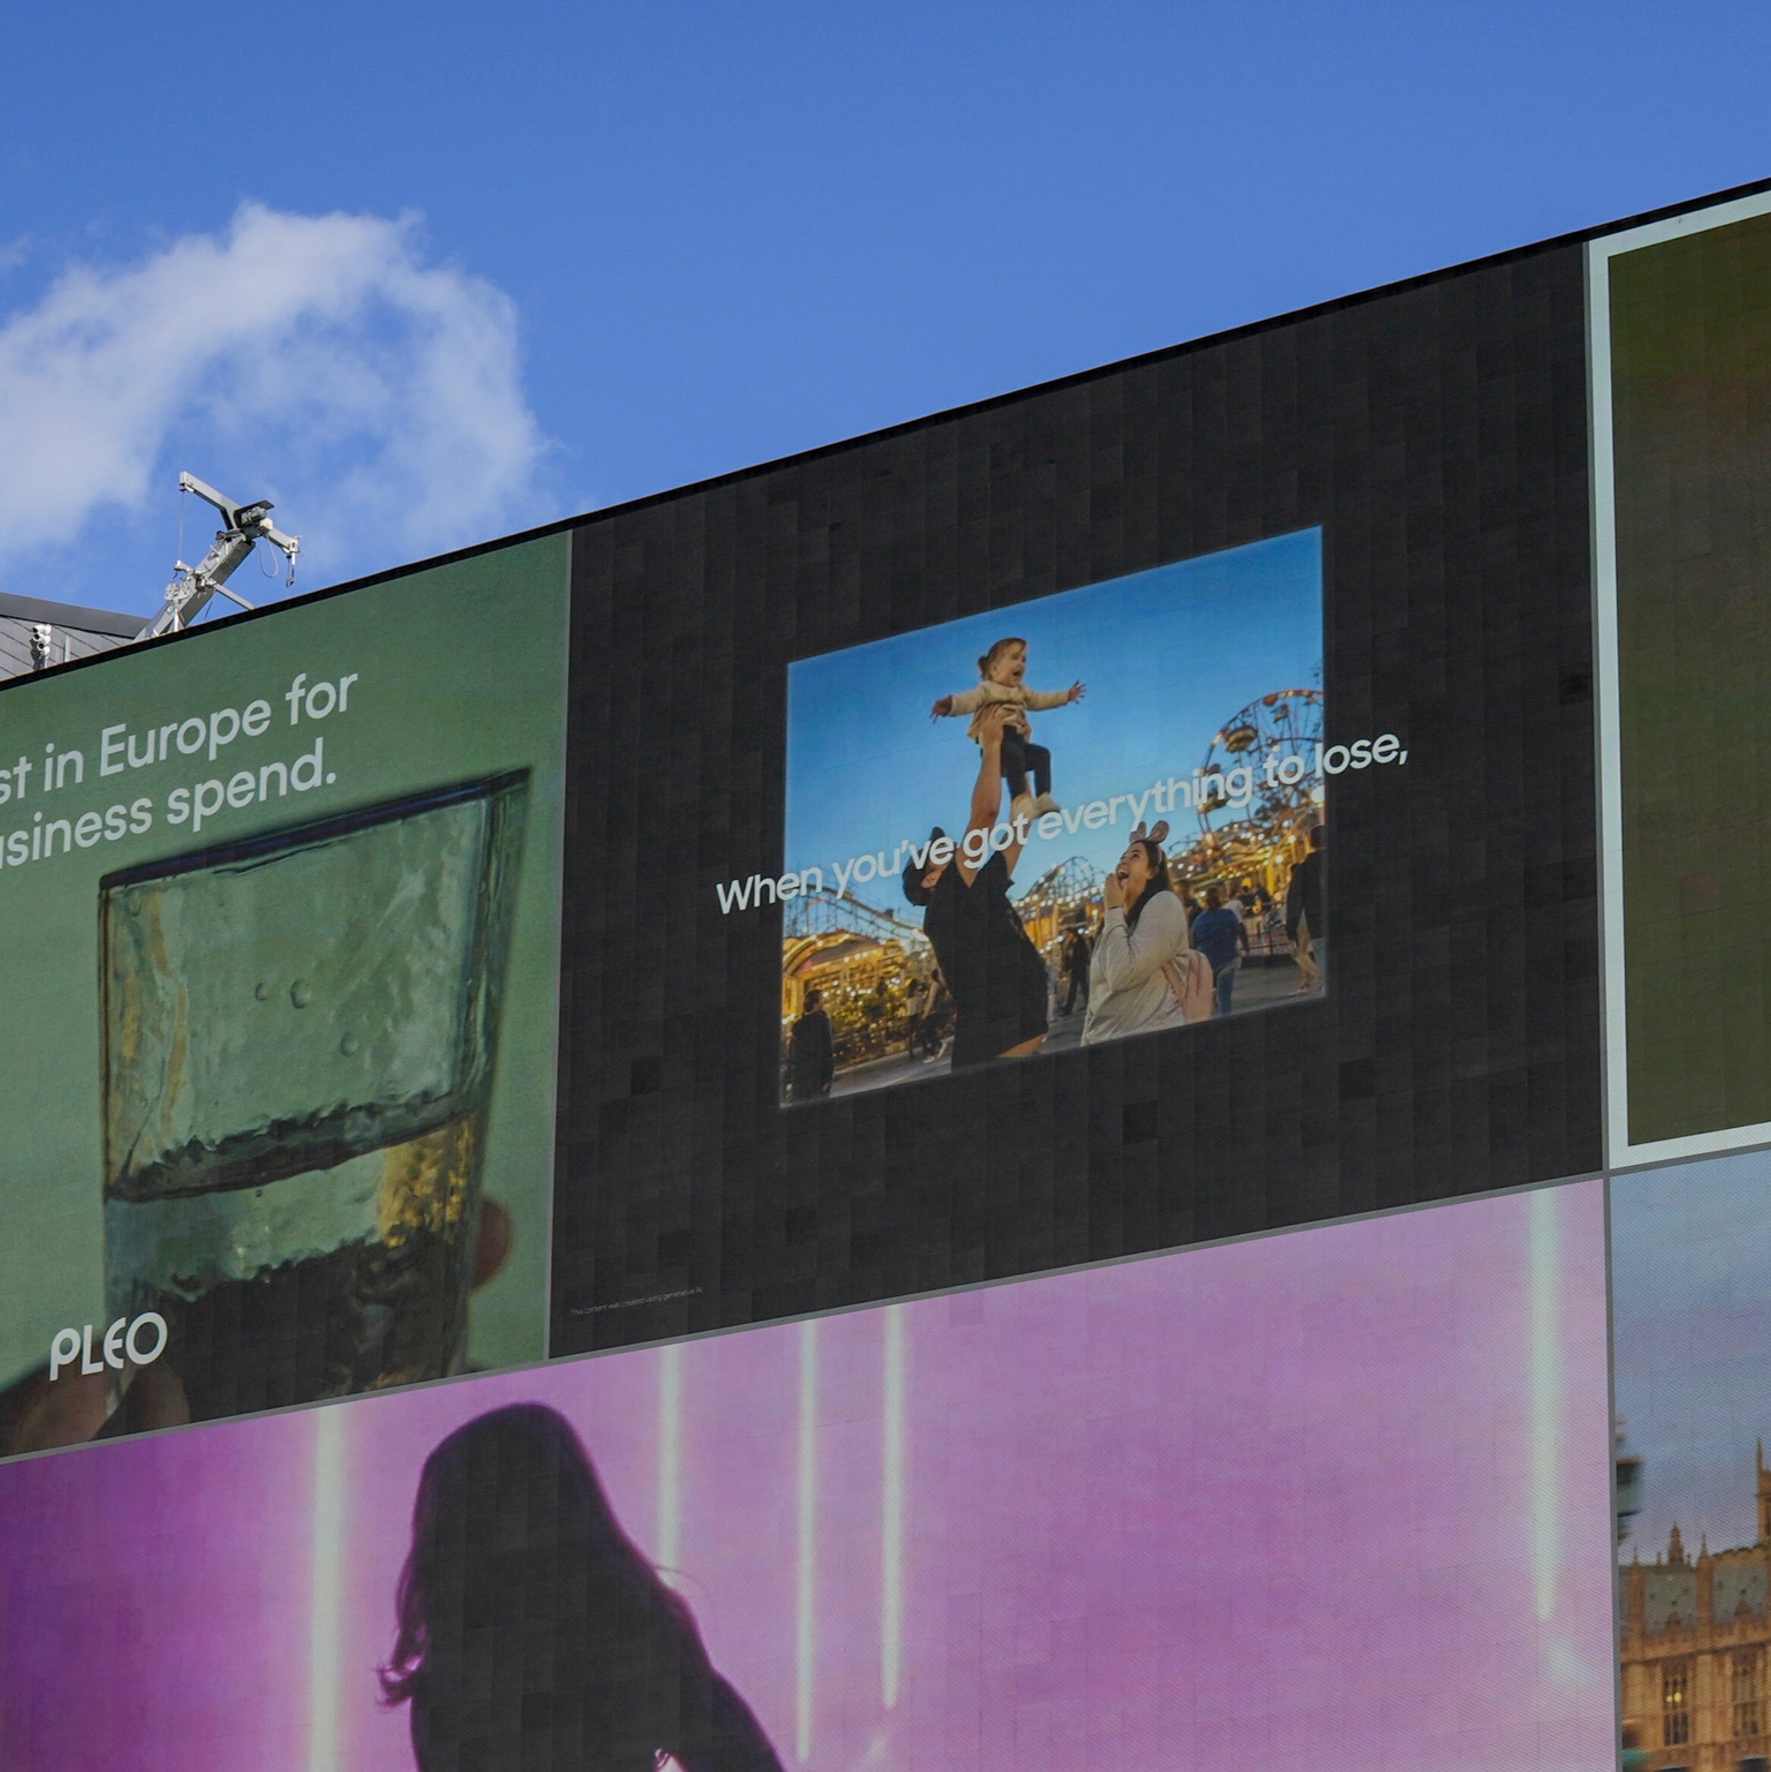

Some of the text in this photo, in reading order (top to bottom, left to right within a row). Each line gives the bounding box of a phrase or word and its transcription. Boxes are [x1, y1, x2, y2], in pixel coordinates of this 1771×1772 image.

[45, 742, 84, 791] in
[99, 698, 272, 779] Europe
[287, 672, 359, 726] for
[167, 737, 338, 832] spend.
[716, 732, 1409, 915] When you've got everything to lose,
[49, 1311, 168, 1382] PLEO
